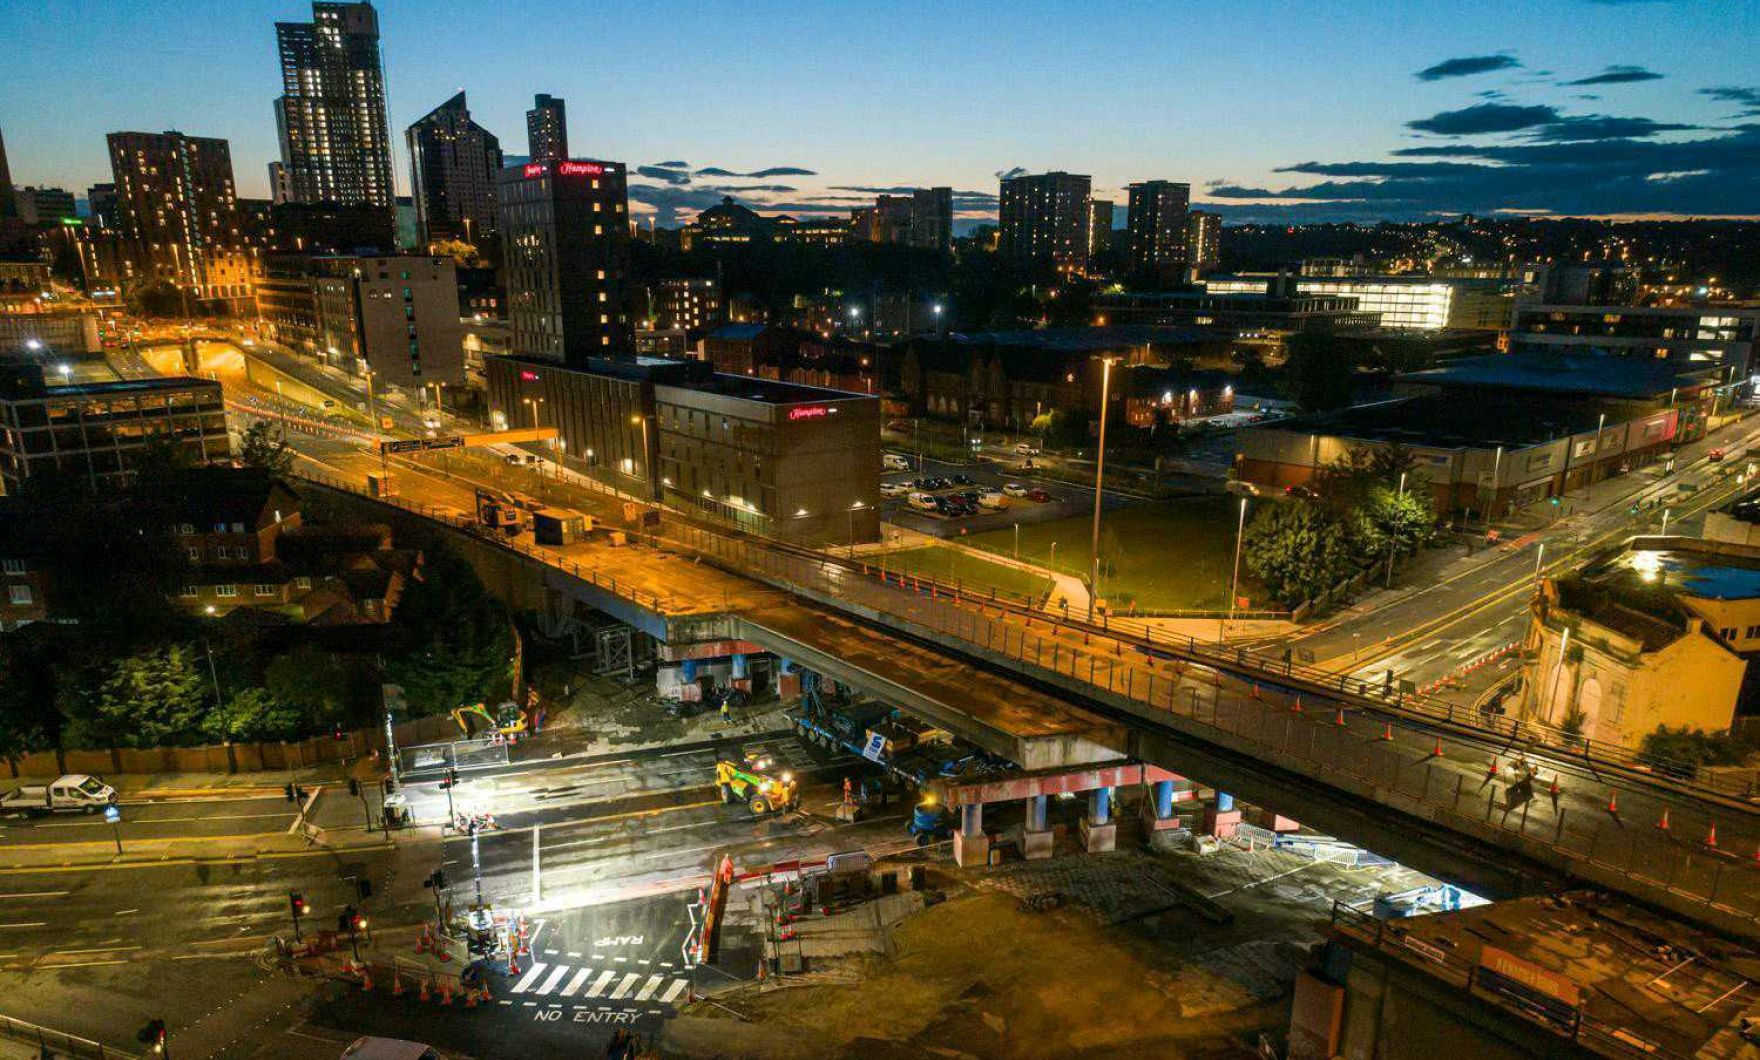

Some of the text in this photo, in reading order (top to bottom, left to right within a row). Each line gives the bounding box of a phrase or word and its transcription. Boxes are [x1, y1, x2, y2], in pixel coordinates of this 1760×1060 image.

[560, 162, 603, 175] Hampton
[593, 935, 644, 947] RAMP
[534, 1010, 643, 1024] NO ENTRY
